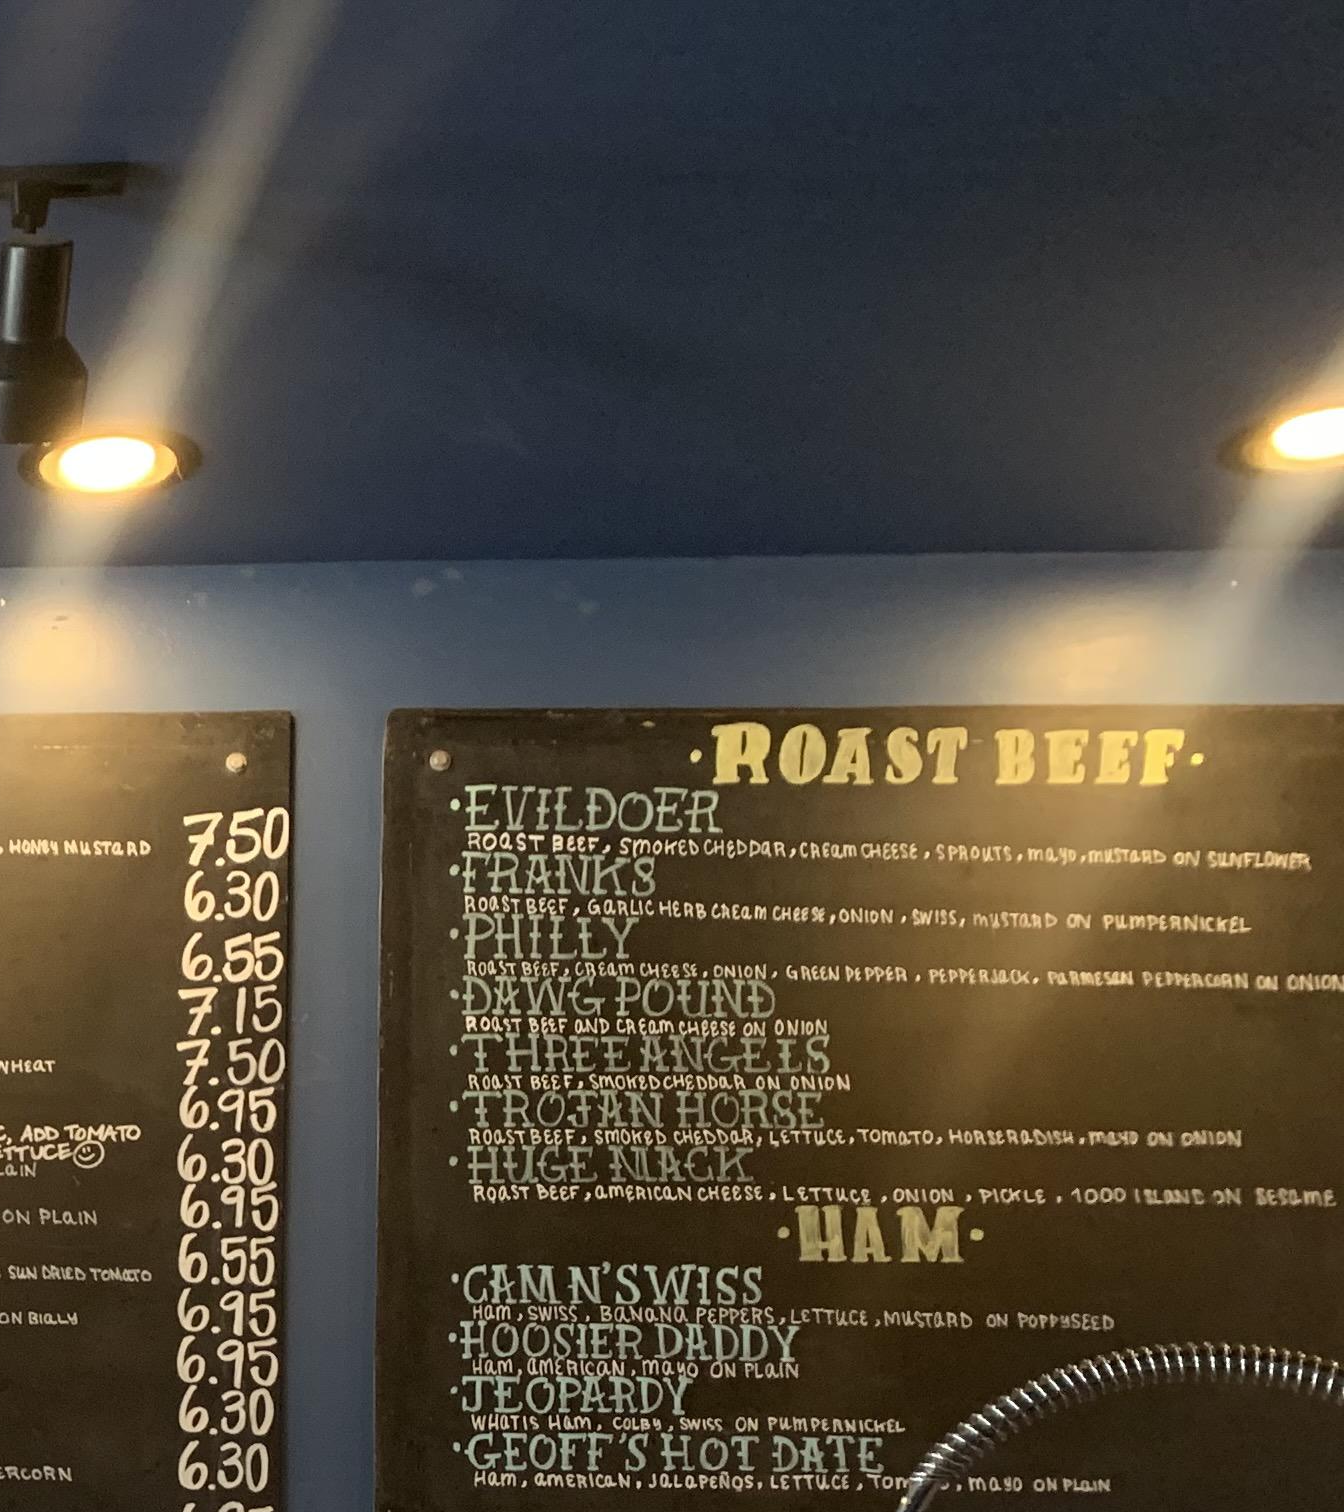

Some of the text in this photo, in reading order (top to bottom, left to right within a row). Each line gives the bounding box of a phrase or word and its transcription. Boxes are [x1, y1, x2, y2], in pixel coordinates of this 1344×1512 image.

[712, 722, 1185, 787] ROAST BEEF
[464, 784, 722, 834] EVILDOER
[183, 808, 289, 867] 7.50
[184, 870, 280, 922] 6.30
[462, 851, 656, 897] FRANKS
[181, 931, 284, 982] 6.55
[463, 913, 640, 960] PHILLY
[177, 985, 283, 1037] 7.15
[743, 1020, 828, 1037] ON ONION
[462, 1033, 830, 1074] THREE ANGELS
[463, 1090, 823, 1129] TROJAN HORSE
[21, 1126, 57, 1142] ADD
[63, 1124, 141, 1143] TOMATO
[795, 1203, 965, 1264] HAM
[460, 1320, 801, 1362] HOOSIER DADDY
[462, 1376, 693, 1415] JEOPARDY
[660, 1434, 884, 1474] HOT DATE
